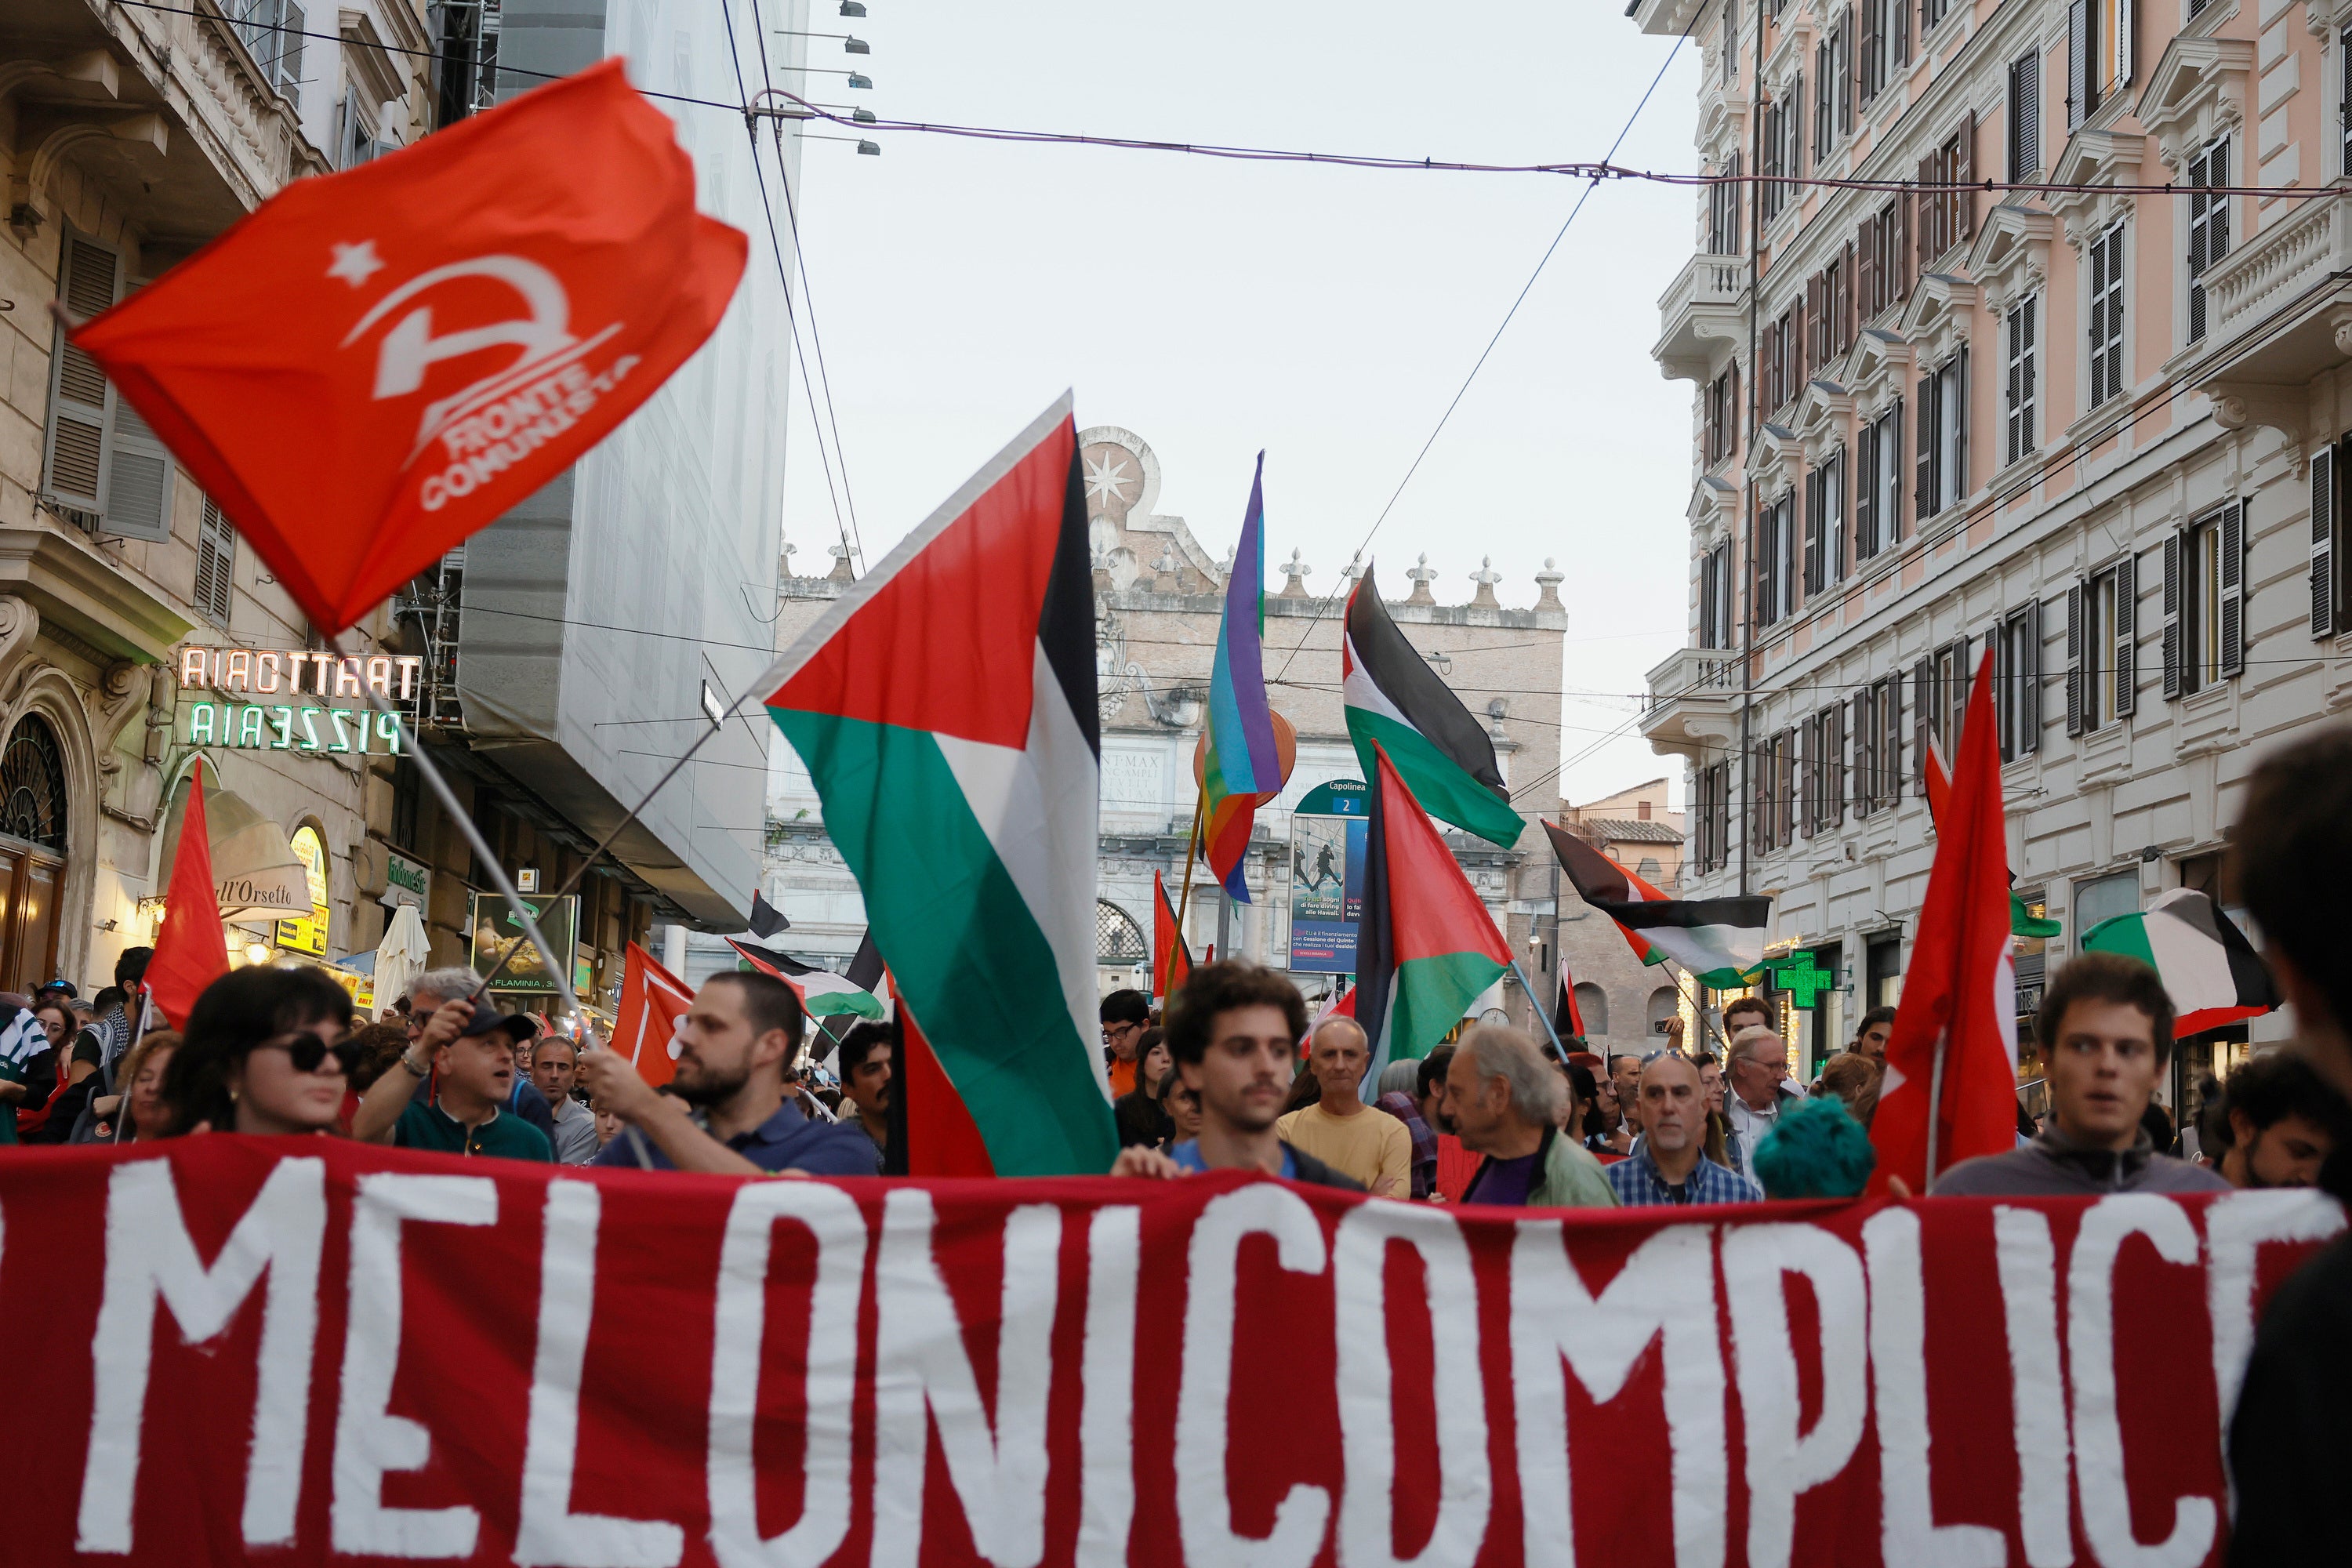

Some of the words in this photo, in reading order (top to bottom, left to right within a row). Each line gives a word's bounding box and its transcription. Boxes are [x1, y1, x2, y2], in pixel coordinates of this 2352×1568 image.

[420, 354, 641, 511] COMUNISTA
[441, 363, 590, 464] FRONTE
[1329, 782, 1366, 791] Capolinea
[1343, 800, 1349, 811] 2
[75, 1156, 1142, 1568] MELONI
